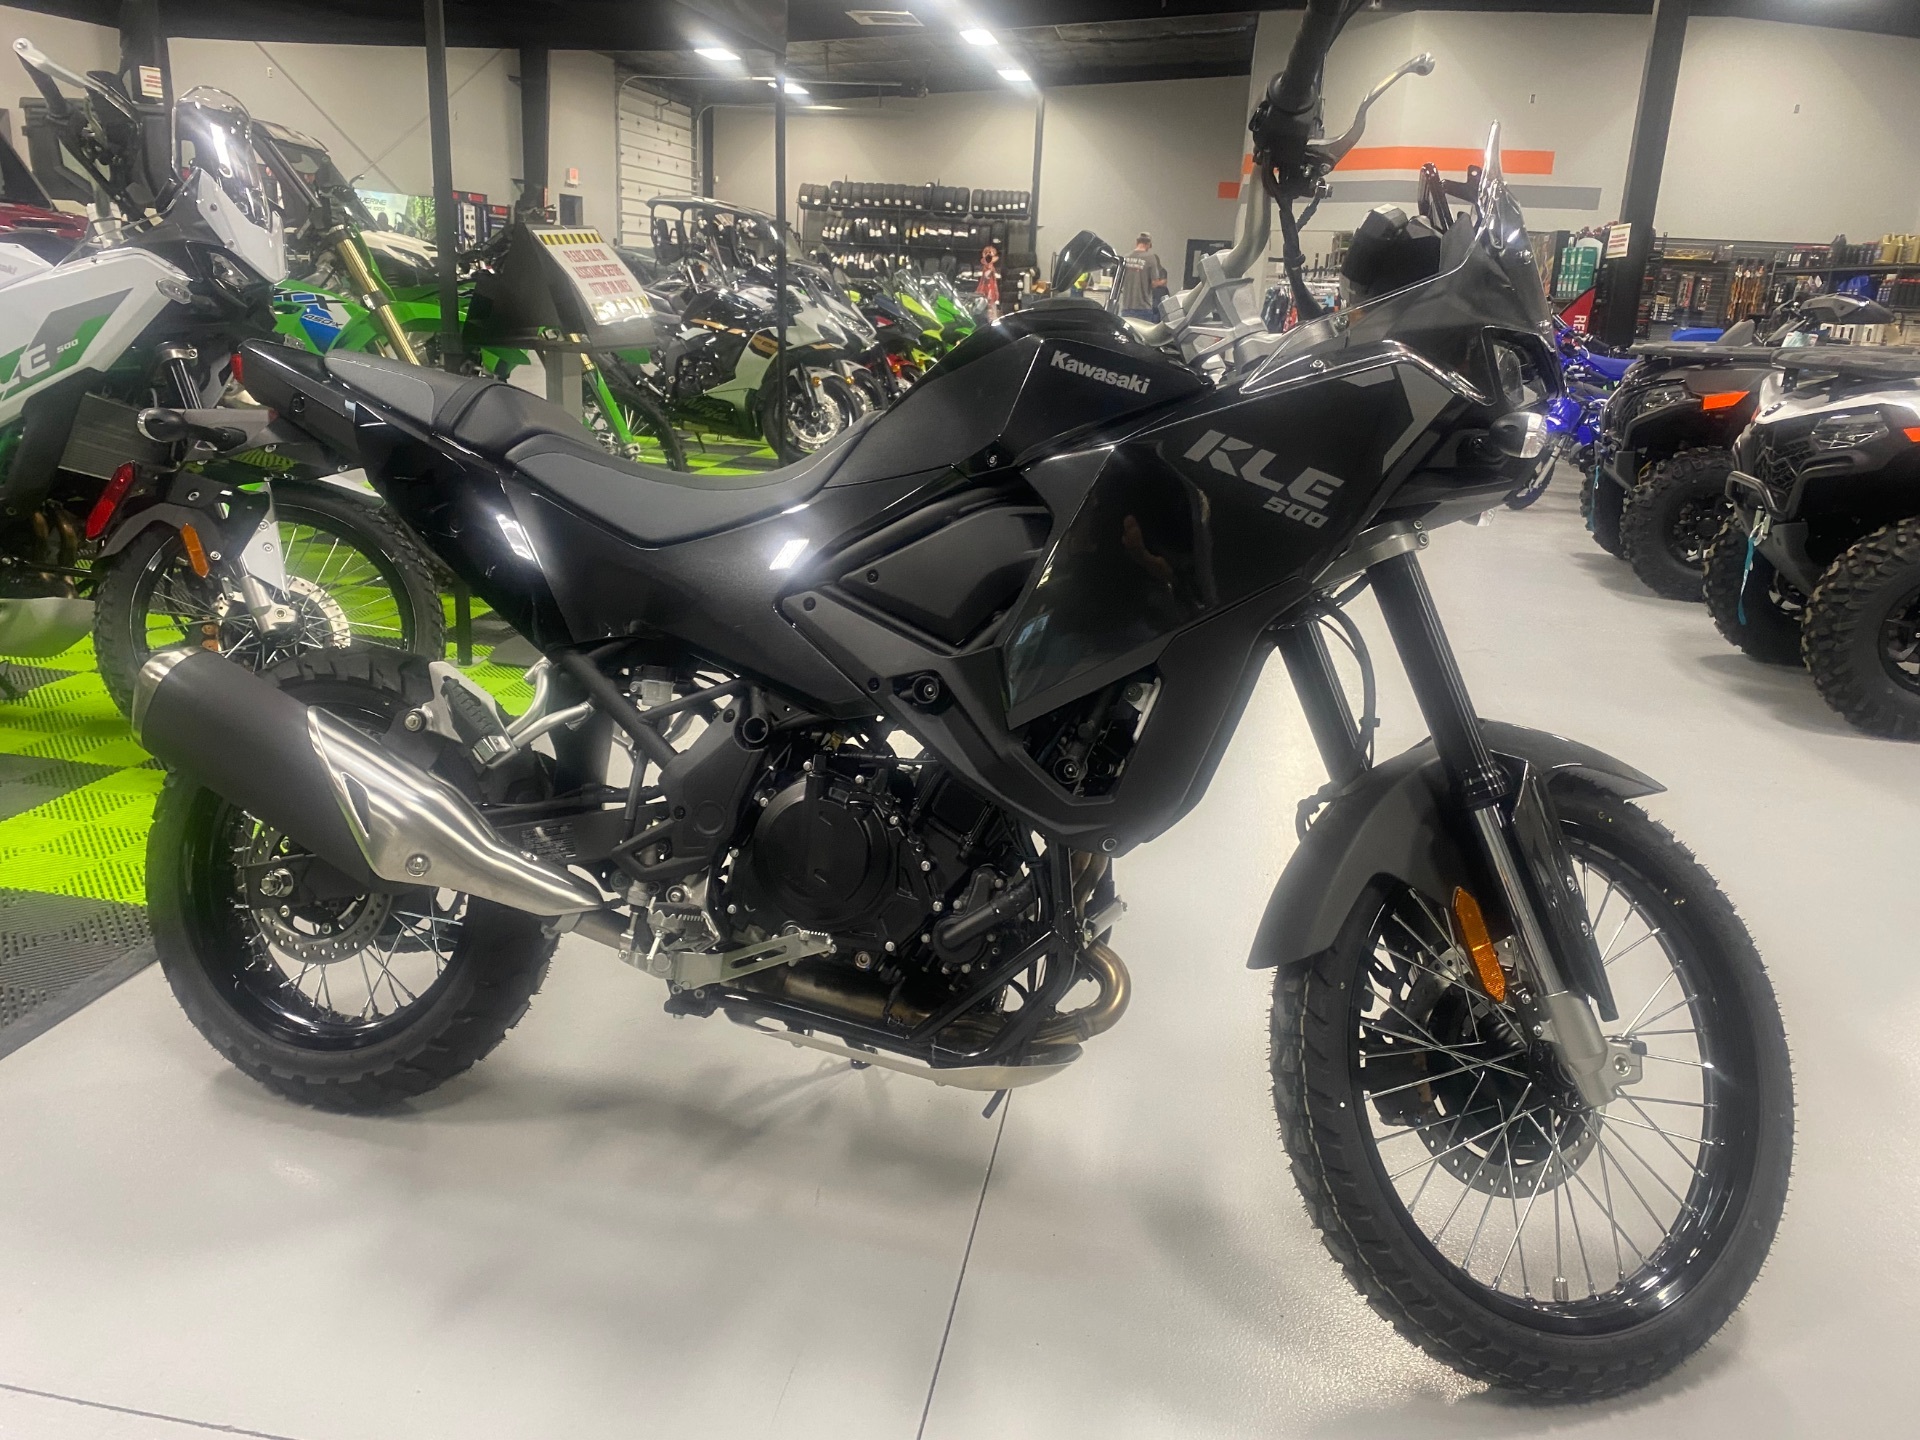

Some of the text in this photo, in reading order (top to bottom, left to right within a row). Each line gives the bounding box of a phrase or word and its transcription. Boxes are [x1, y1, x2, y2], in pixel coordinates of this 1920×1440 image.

[1573, 315, 1587, 333] RE
[56, 338, 79, 354] 500
[1050, 350, 1151, 394] Kawasaki
[1183, 429, 1345, 509] KLE
[1262, 496, 1329, 529] 500
